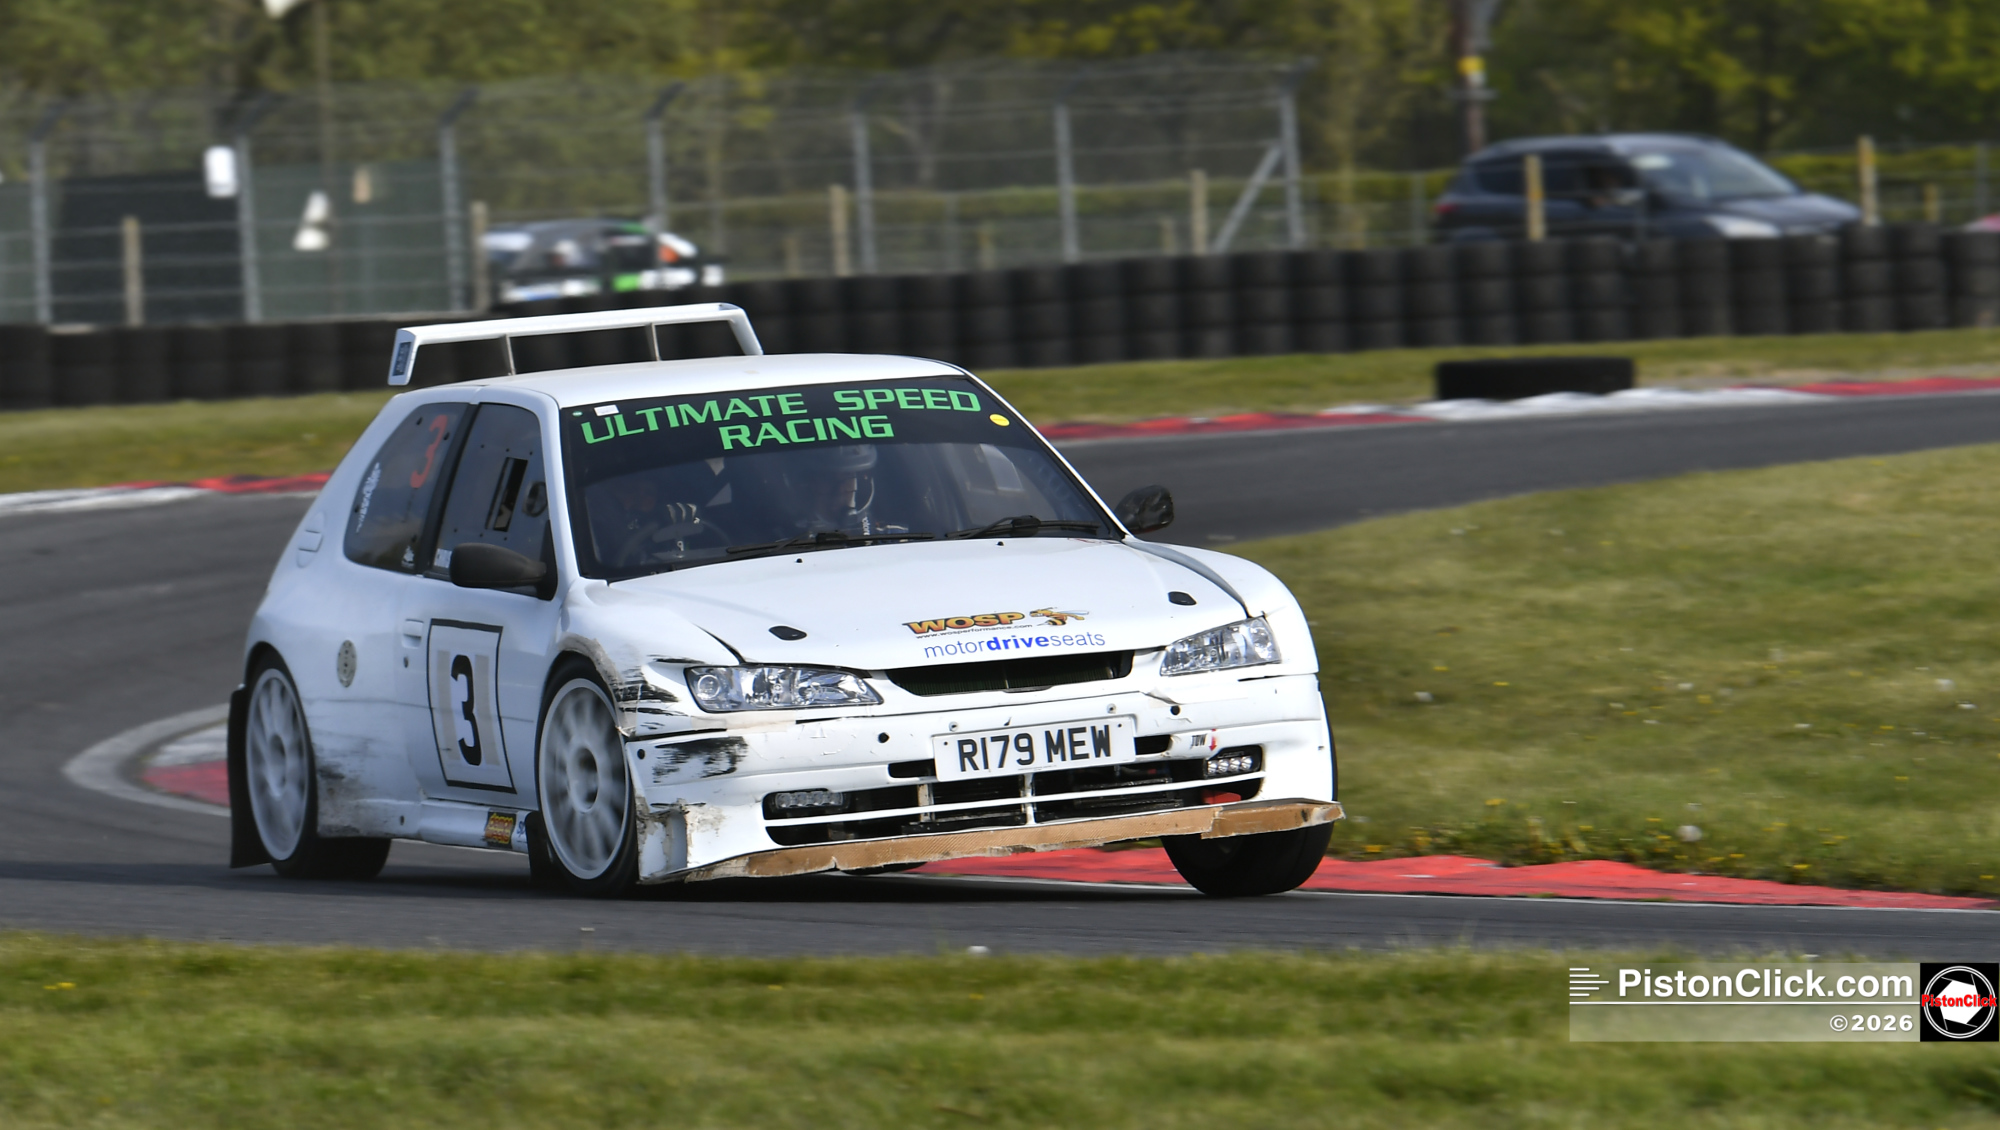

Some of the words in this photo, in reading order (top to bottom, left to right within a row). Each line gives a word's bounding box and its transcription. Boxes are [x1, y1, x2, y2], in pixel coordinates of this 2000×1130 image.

[581, 393, 807, 444] ULTIMATE
[833, 388, 981, 412] SPEED
[718, 415, 894, 450] RACING
[410, 414, 447, 488] 3
[902, 612, 1025, 635] WOSP
[924, 632, 1106, 659] motordriveseats
[451, 654, 482, 766] 3
[957, 733, 1035, 772] R179
[1044, 725, 1111, 763] MEW
